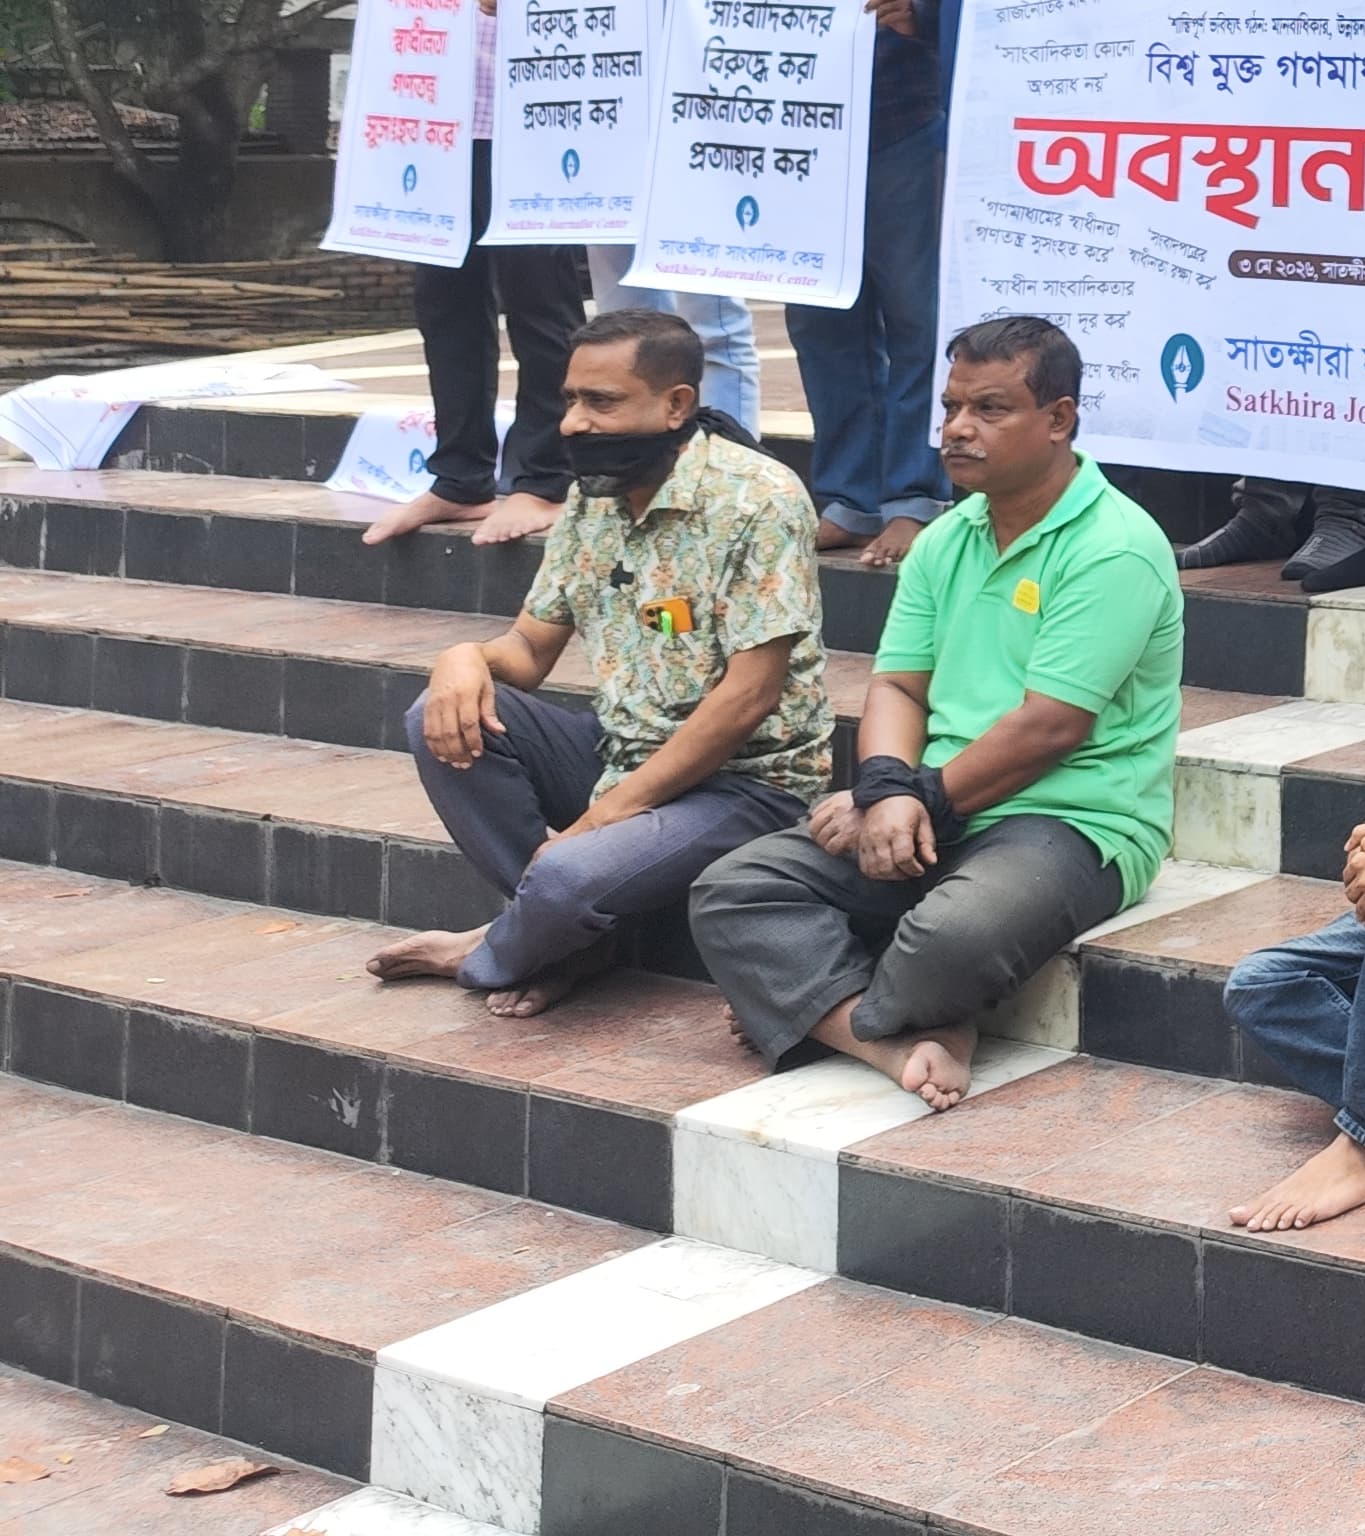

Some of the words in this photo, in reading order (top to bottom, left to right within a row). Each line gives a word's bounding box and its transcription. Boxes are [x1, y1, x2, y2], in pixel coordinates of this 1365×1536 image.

[526, 0, 578, 40] বিরুদ্ধে
[584, 5, 616, 37] করা
[508, 43, 586, 88] রাজনৈতিক
[592, 50, 643, 78] মামলা
[702, 35, 772, 83] বিরুদ্ধে
[778, 51, 817, 85] করা
[1094, 40, 1136, 59] কোনো
[1145, 42, 1200, 86] বিশ্ব
[1208, 55, 1266, 95] মুক্ত
[523, 100, 582, 131] প্রত্যাহার
[672, 84, 776, 125] রাজনৈতিক
[781, 100, 844, 130] মামলা
[689, 141, 766, 178] প্রত্যাহার
[773, 147, 818, 182] কর’
[1043, 274, 1135, 298] সাংবাদিকতার
[1239, 261, 1251, 274] ৩
[1255, 259, 1273, 275] মে
[1275, 261, 1320, 282] ২০২৬,
[1224, 329, 1354, 380] সাতক্ষীরা
[1226, 385, 1336, 420] Satkhira
